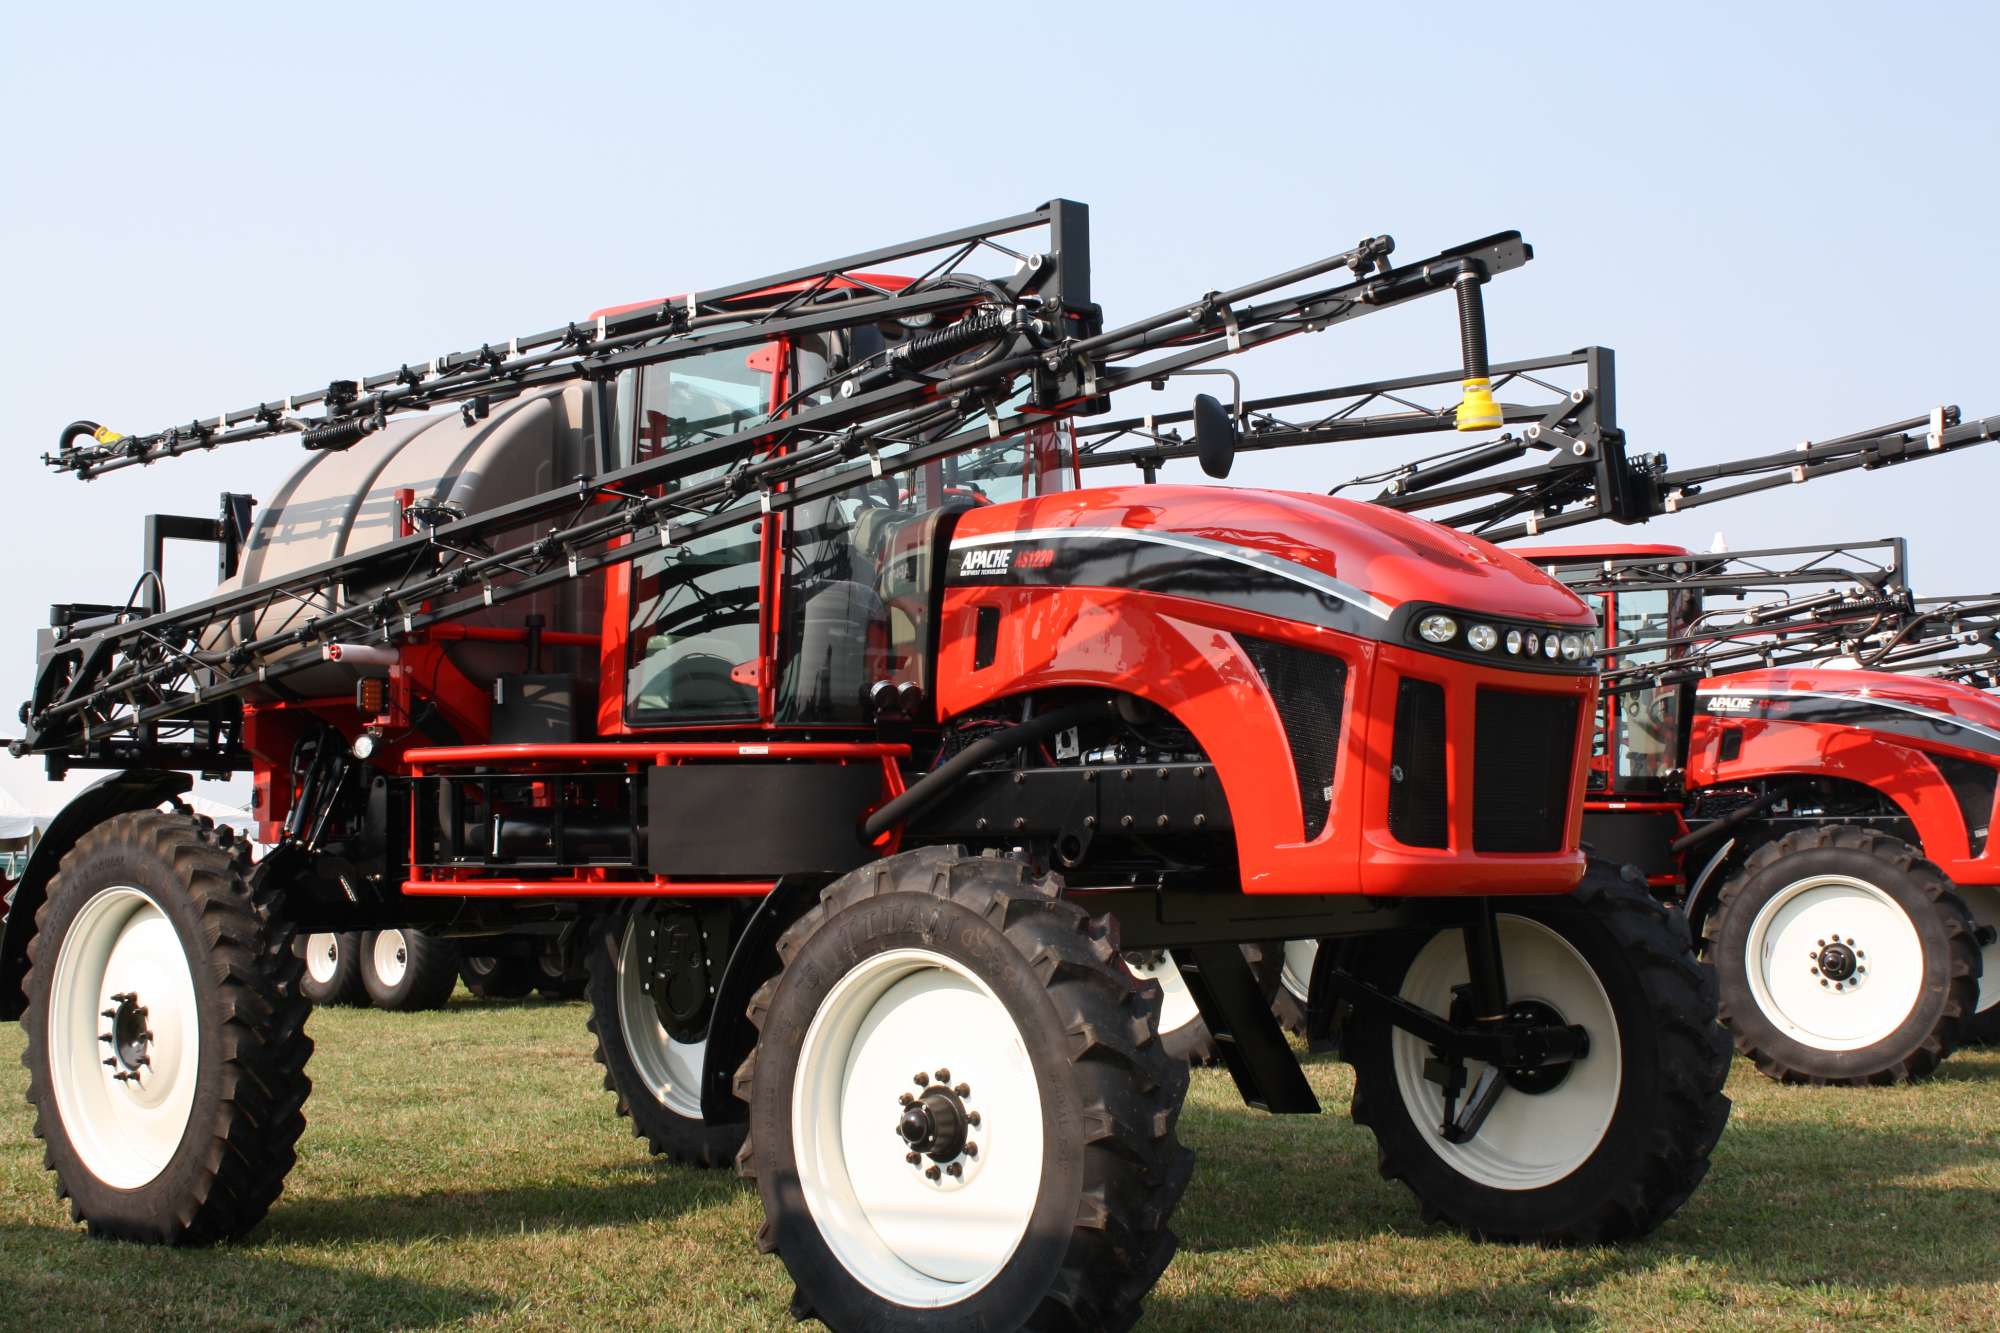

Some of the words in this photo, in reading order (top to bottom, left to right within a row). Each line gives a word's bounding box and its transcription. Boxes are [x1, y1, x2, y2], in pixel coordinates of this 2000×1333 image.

[961, 549, 1012, 570] APACHE
[1707, 696, 1754, 709] APACHE
[839, 903, 960, 952] TITAN
